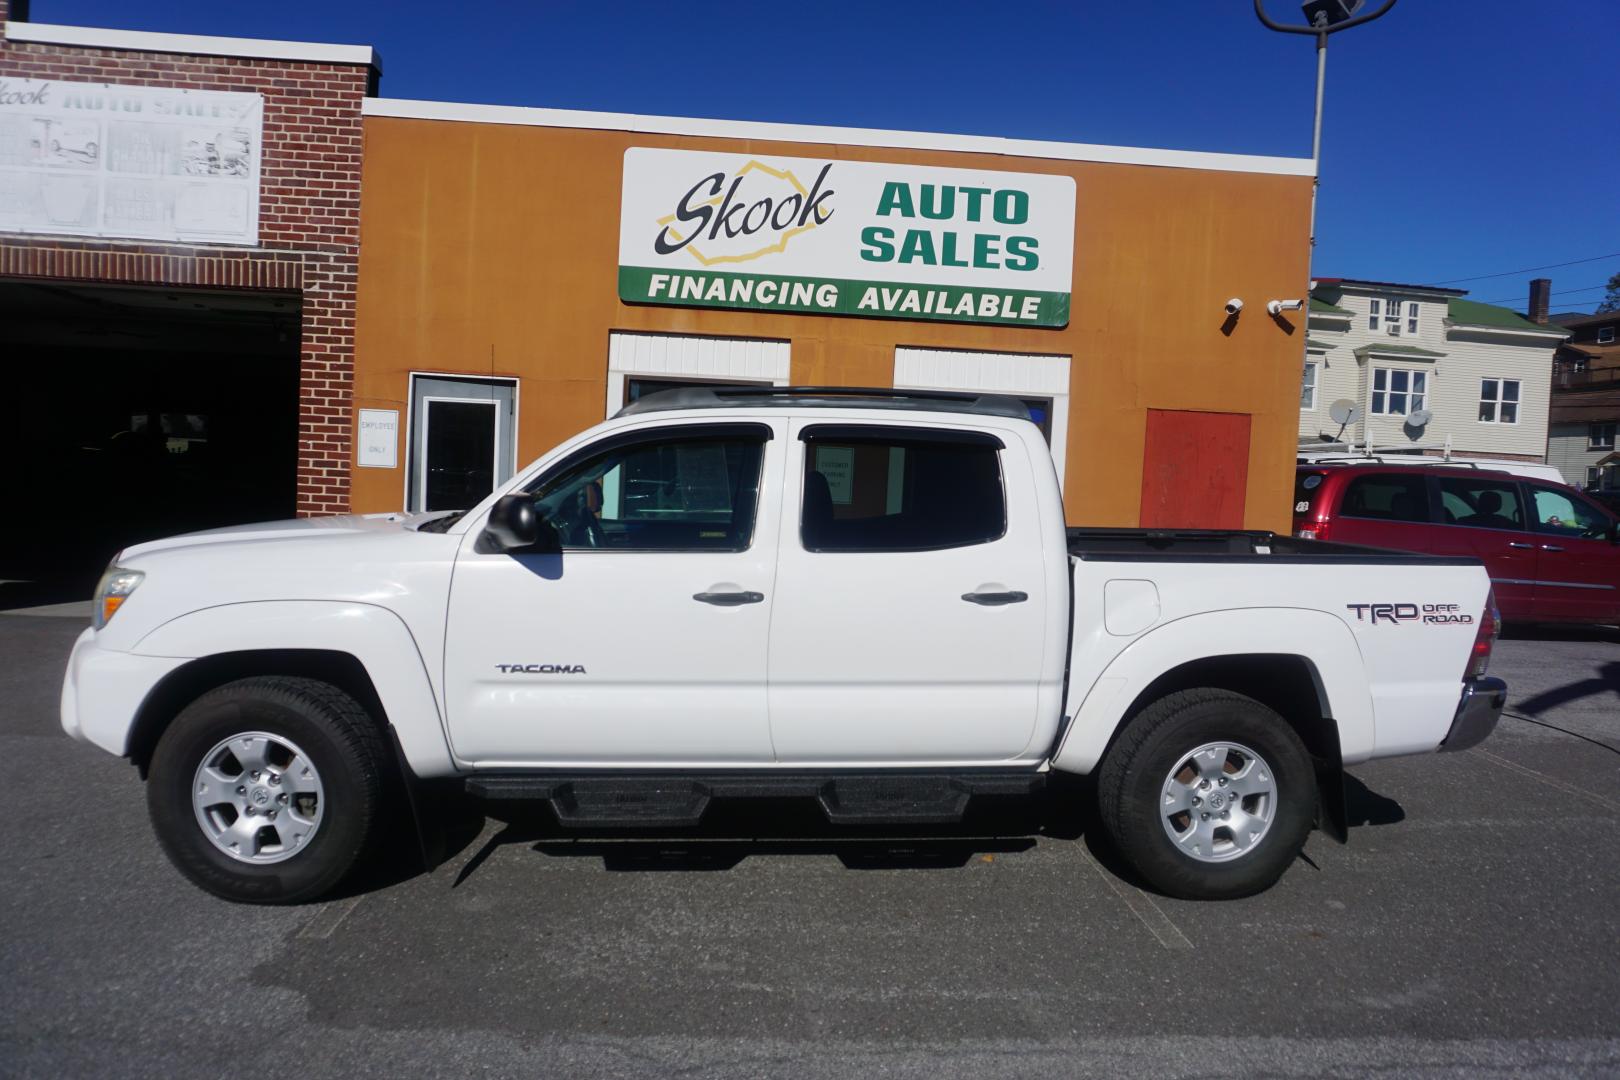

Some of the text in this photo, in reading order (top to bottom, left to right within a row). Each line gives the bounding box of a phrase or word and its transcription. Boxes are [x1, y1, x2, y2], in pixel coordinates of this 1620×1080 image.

[0, 80, 49, 105] kook
[654, 163, 835, 255] Skook
[876, 181, 1030, 225] AUTO
[860, 226, 1040, 272] SALES
[648, 274, 1042, 320] FINANCING AVAILABLE
[1346, 603, 1460, 625] TRD OFF
[1422, 614, 1474, 625] ROAD
[495, 664, 586, 674] TACOMA
